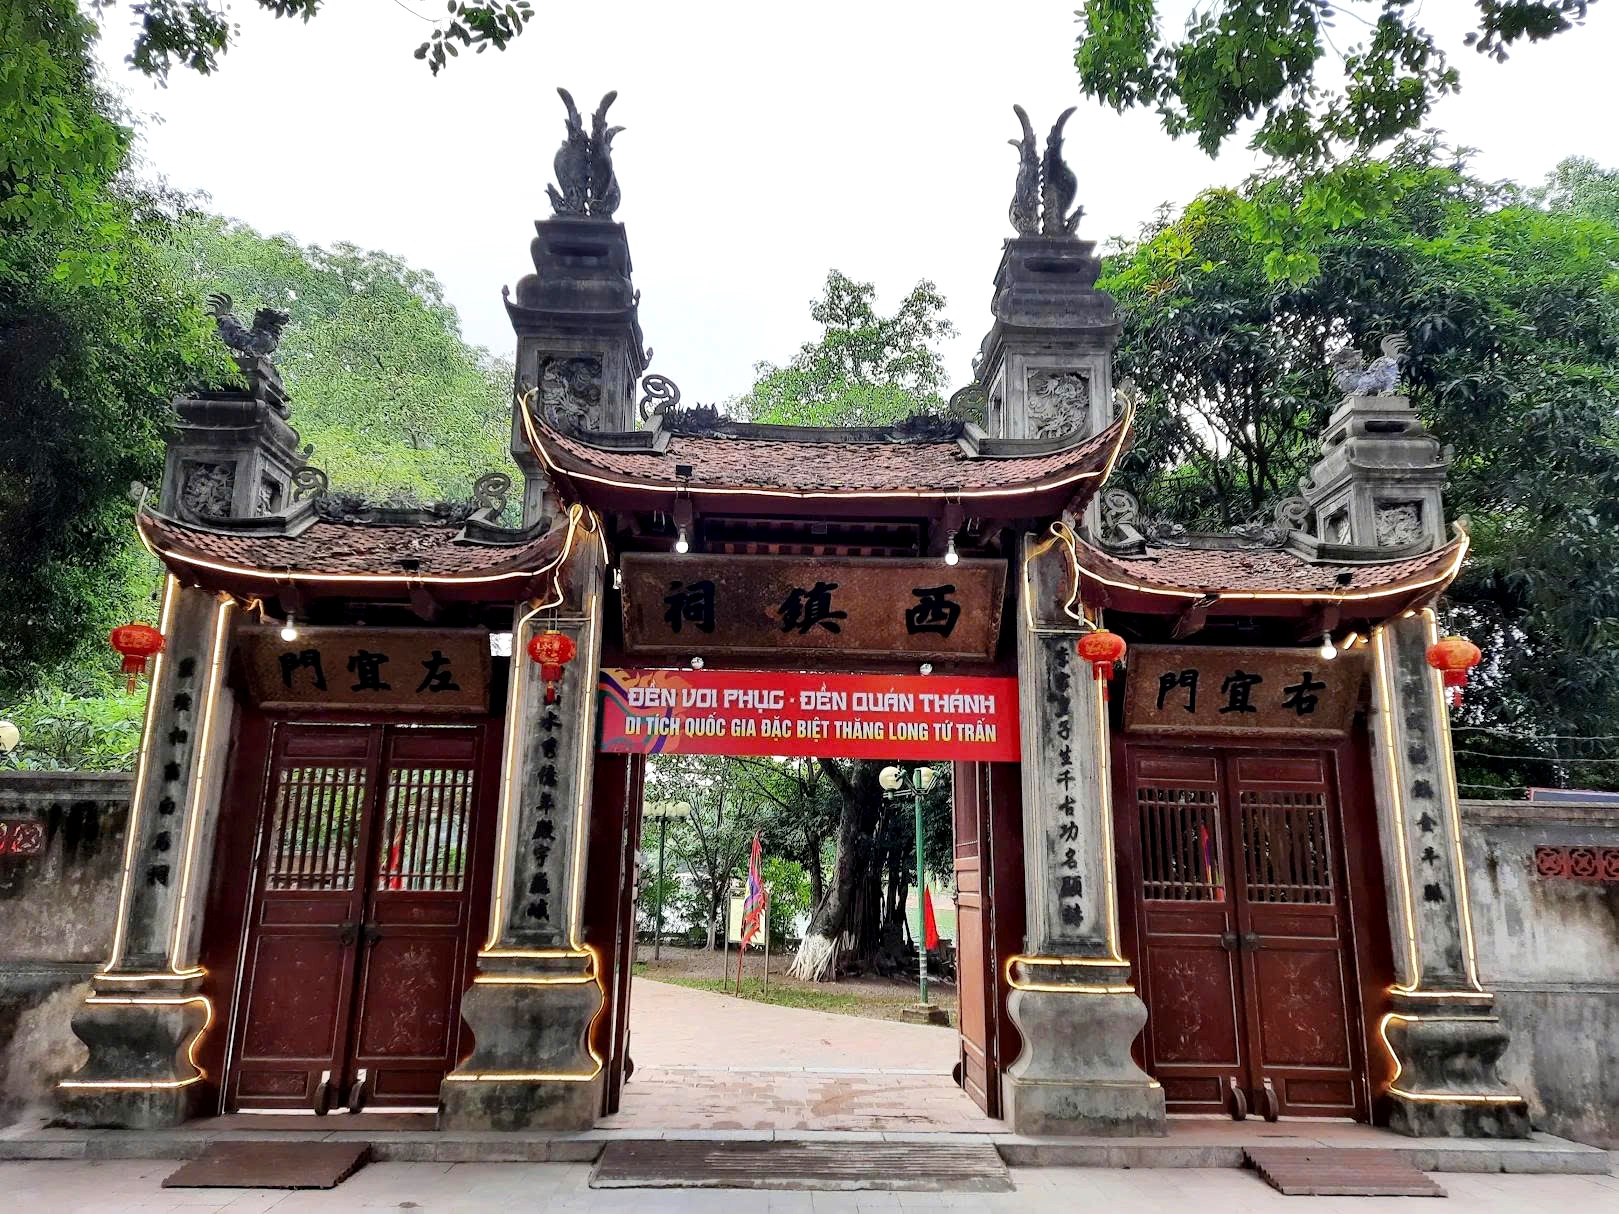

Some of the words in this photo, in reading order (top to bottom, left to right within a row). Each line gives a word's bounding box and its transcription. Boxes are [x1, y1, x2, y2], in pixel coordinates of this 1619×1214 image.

[628, 680, 676, 707] ĐỀN
[682, 688, 718, 708] VOI
[724, 689, 785, 713] PHỤC
[800, 681, 847, 711] ĐỀN
[852, 687, 914, 713] QUÁN
[919, 688, 996, 714] THÁNH
[625, 716, 641, 735] DI
[645, 713, 680, 736] TÍCH
[685, 711, 726, 737] QUỐC
[731, 718, 757, 737] GIA
[761, 716, 792, 742] ĐẶC
[797, 716, 830, 742] BIỆT
[834, 717, 885, 741] THĂNG
[889, 721, 929, 741] LONG
[933, 719, 954, 742] TỨ
[956, 717, 996, 743] TRẤN
